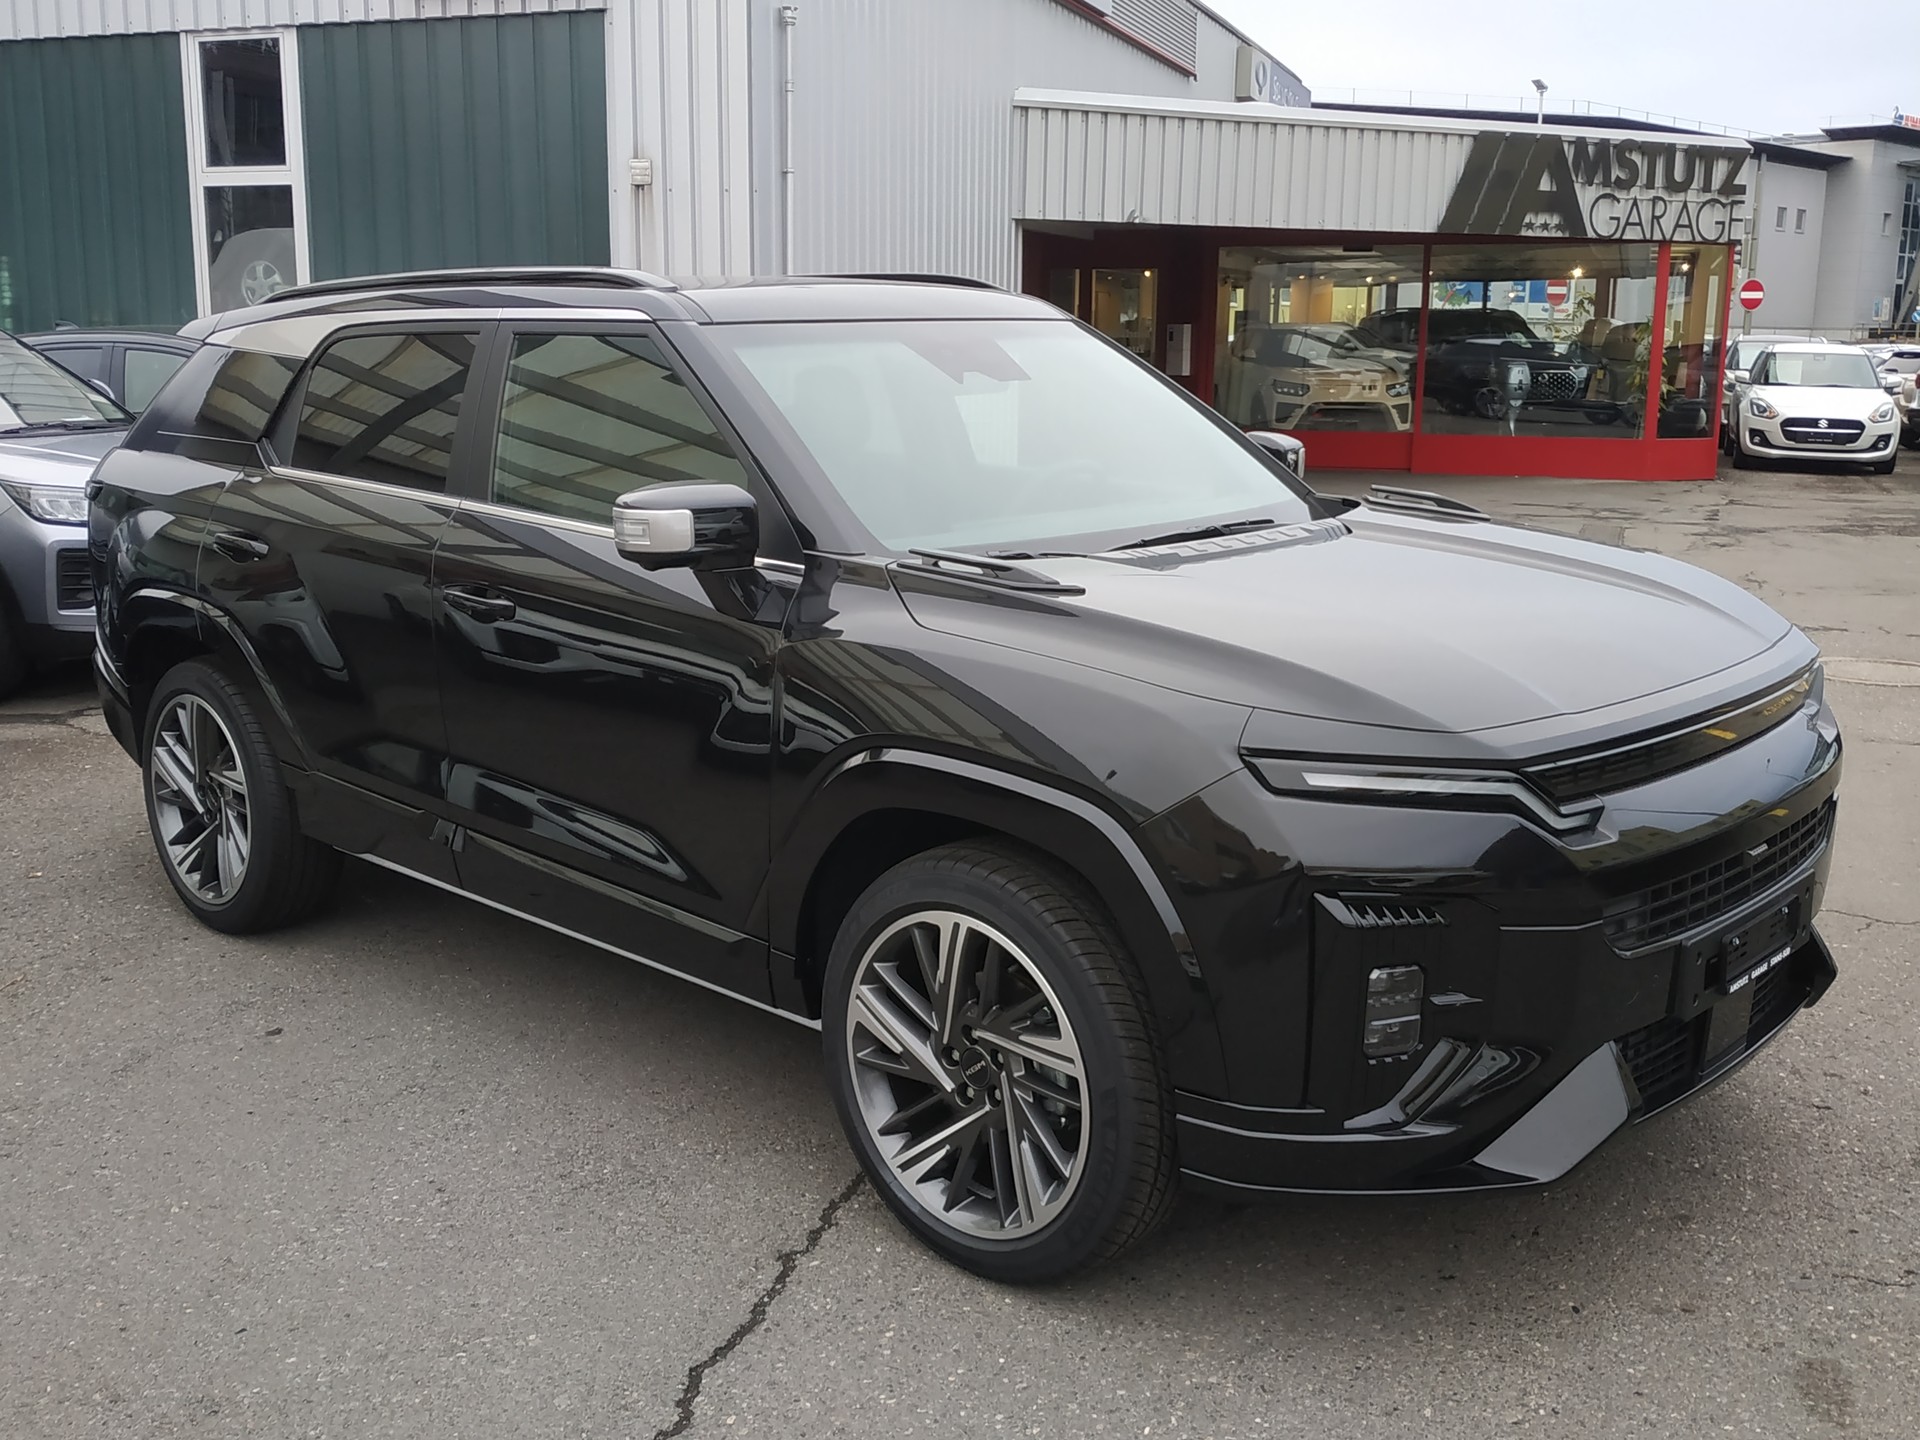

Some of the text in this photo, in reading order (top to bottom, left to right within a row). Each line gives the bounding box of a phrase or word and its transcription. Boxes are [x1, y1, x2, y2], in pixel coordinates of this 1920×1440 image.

[1496, 132, 1752, 238] AMSTUTZ
[1589, 193, 1746, 246] GARAGE
[1751, 961, 1768, 980] GARAGE
[965, 1060, 987, 1076] KGM
